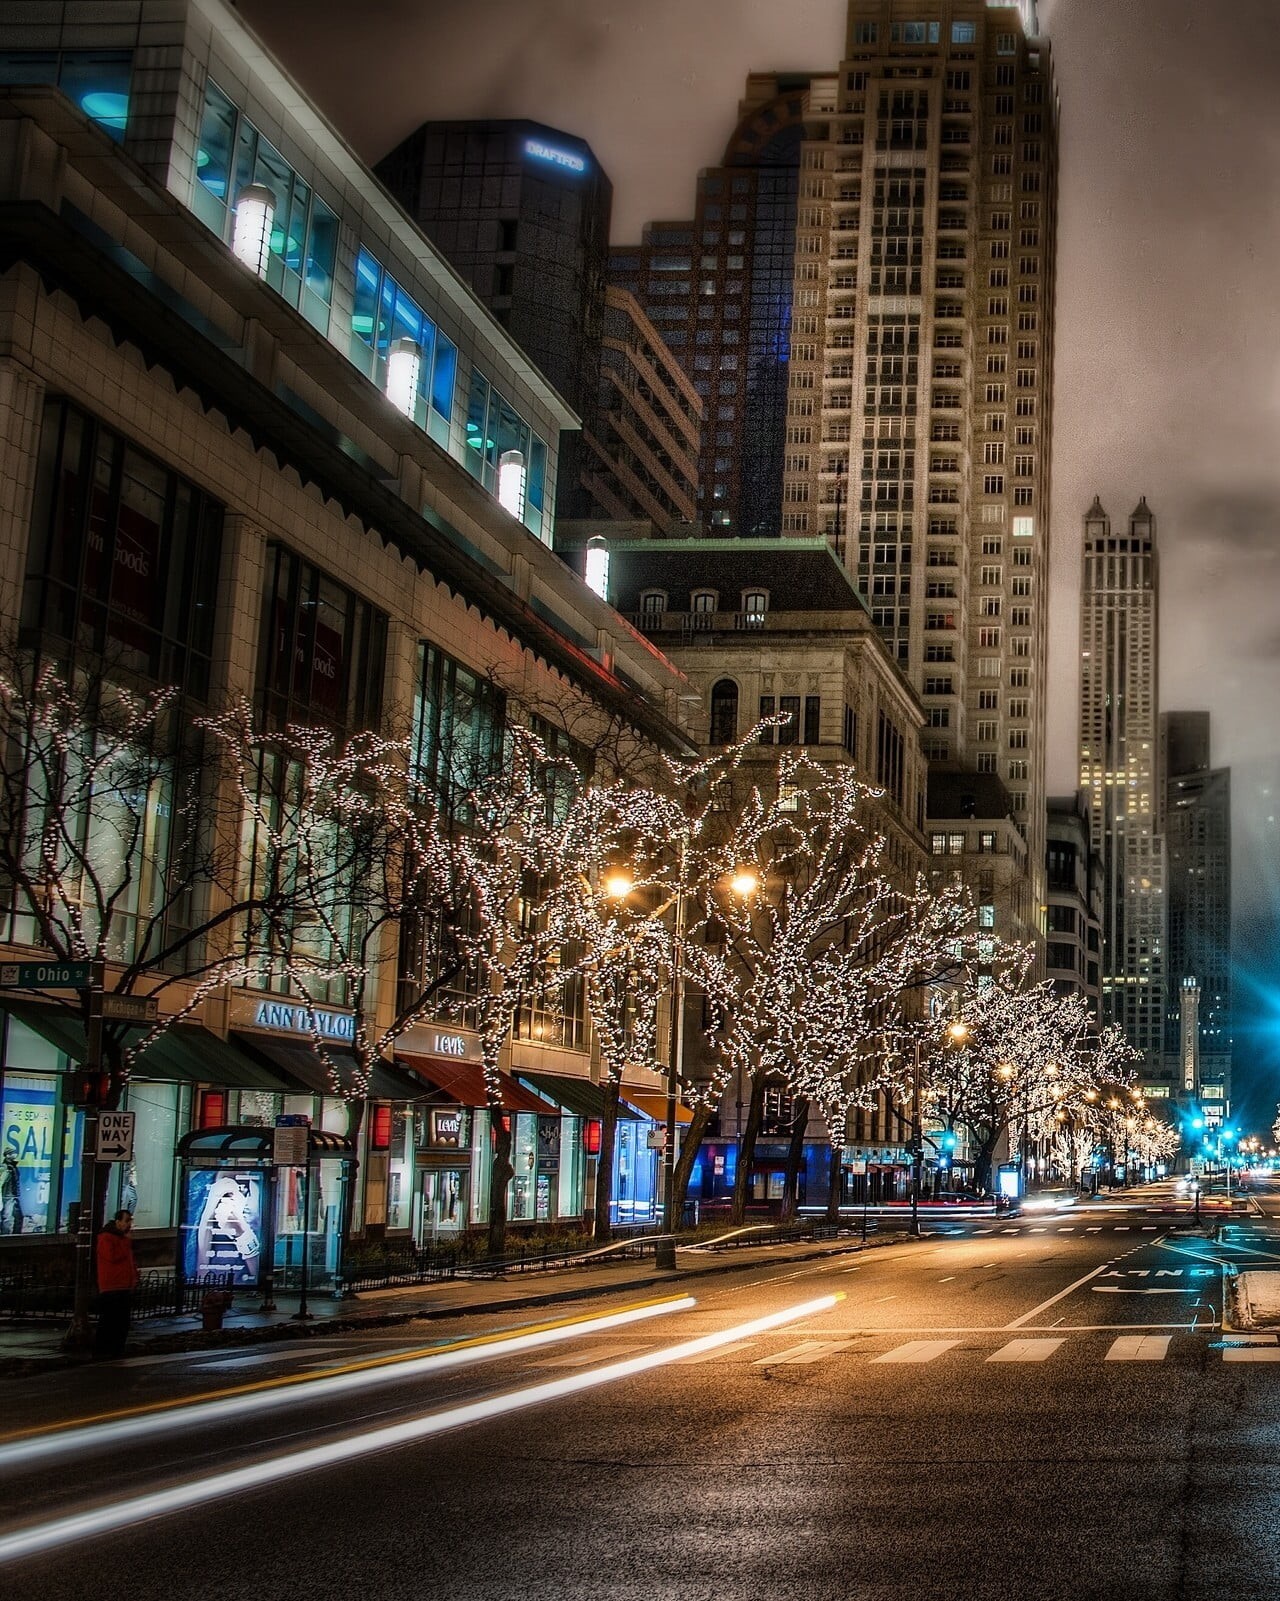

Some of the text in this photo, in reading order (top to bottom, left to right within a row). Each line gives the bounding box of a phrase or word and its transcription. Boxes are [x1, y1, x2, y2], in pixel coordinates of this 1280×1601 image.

[37, 966, 70, 982] Ohio
[258, 1003, 355, 1037] ANN TYLO
[102, 1116, 130, 1128] ONE
[101, 1130, 131, 1142] WAY
[1098, 1268, 1216, 1277] ONLY
